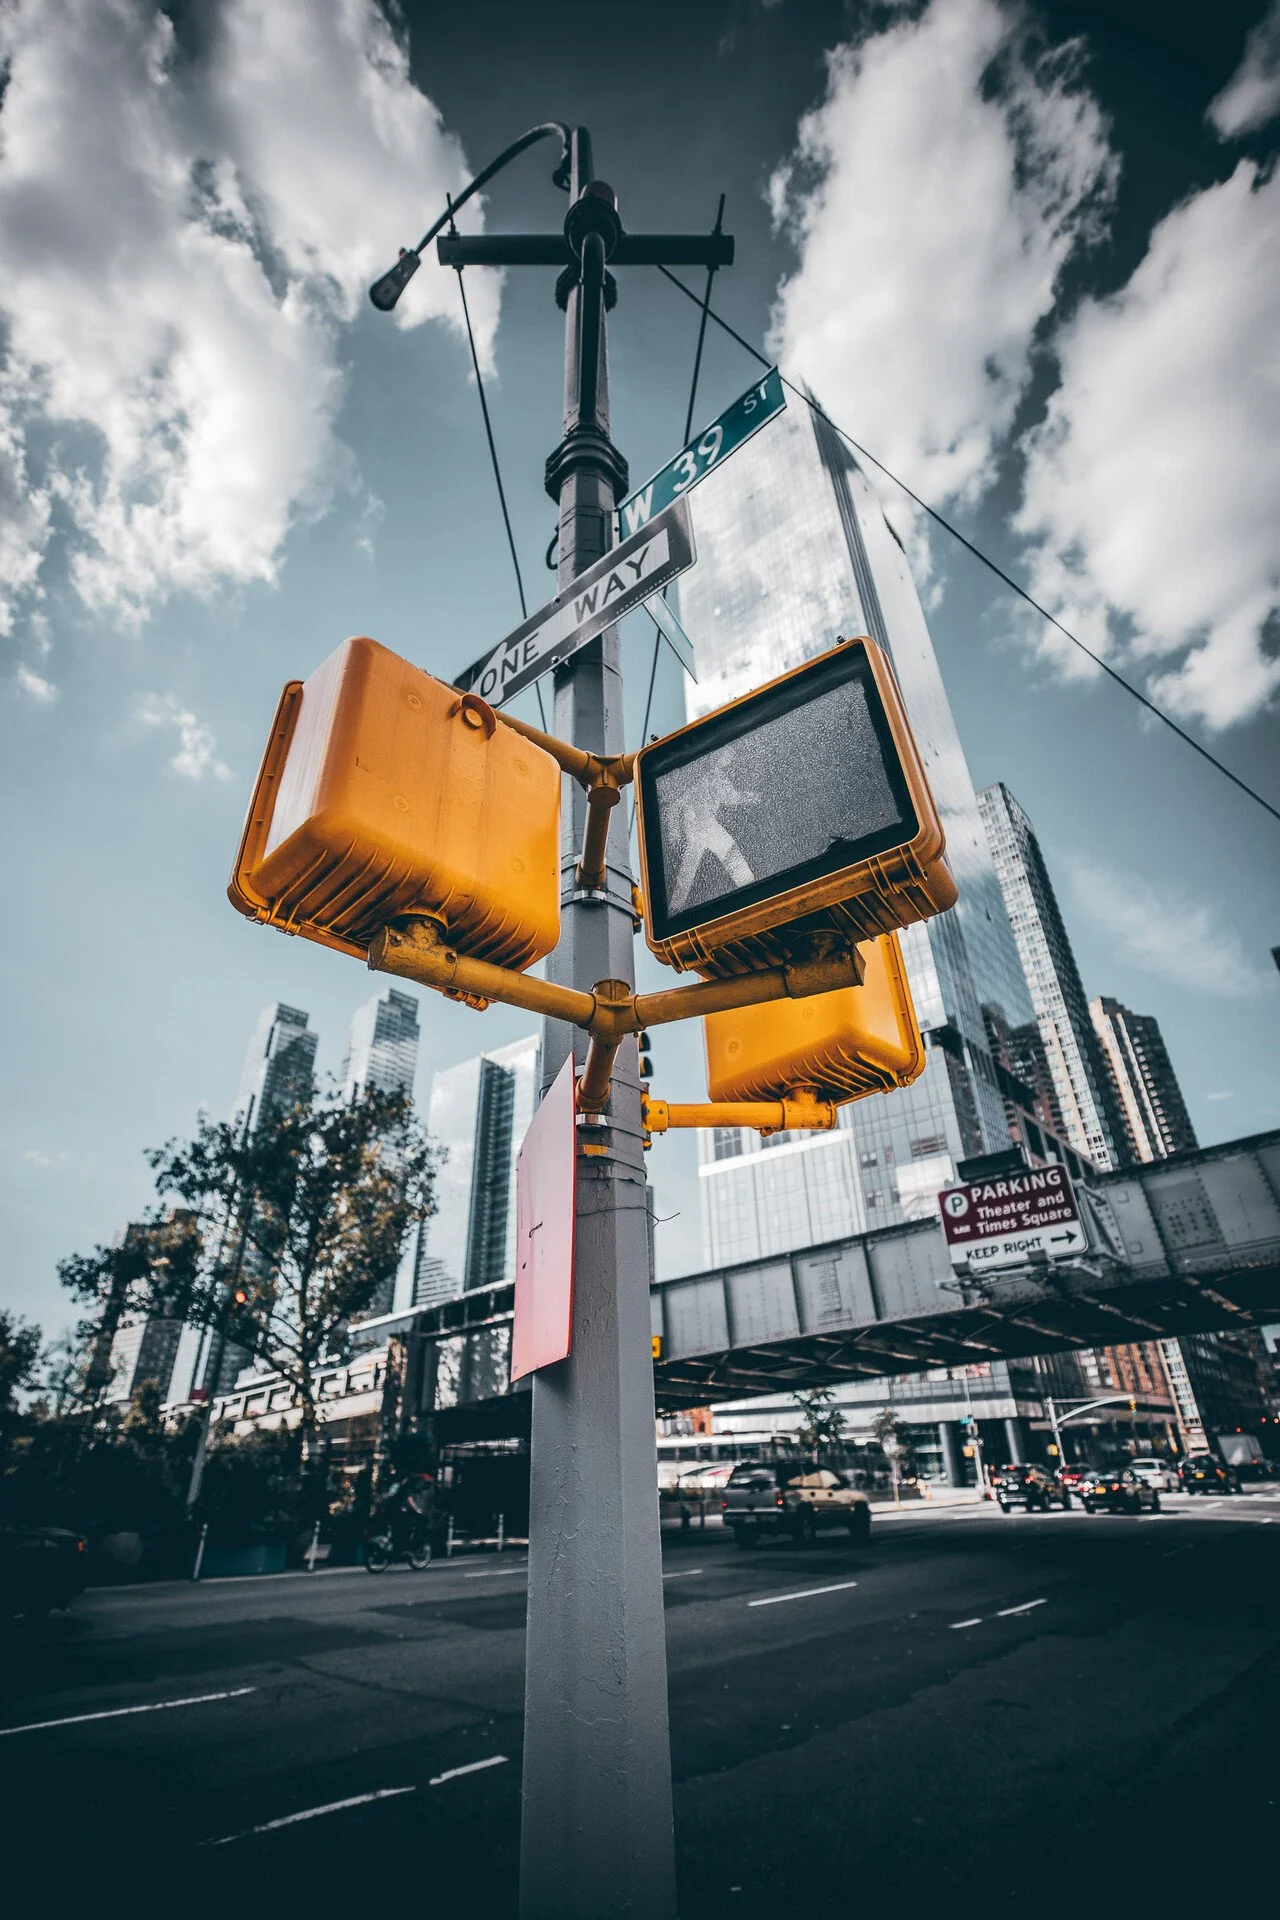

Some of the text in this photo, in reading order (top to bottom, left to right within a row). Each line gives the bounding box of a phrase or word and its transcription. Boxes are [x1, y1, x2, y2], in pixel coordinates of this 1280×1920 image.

[623, 380, 768, 534] W 39 ST
[480, 632, 539, 697] ONE
[574, 545, 650, 624] WAY
[970, 1169, 1062, 1203] PARKING
[977, 1190, 1065, 1219] Theater and
[977, 1218, 1018, 1234] Times
[1021, 1207, 1072, 1226] Square
[966, 1237, 1042, 1260] KEEP RIGHT
